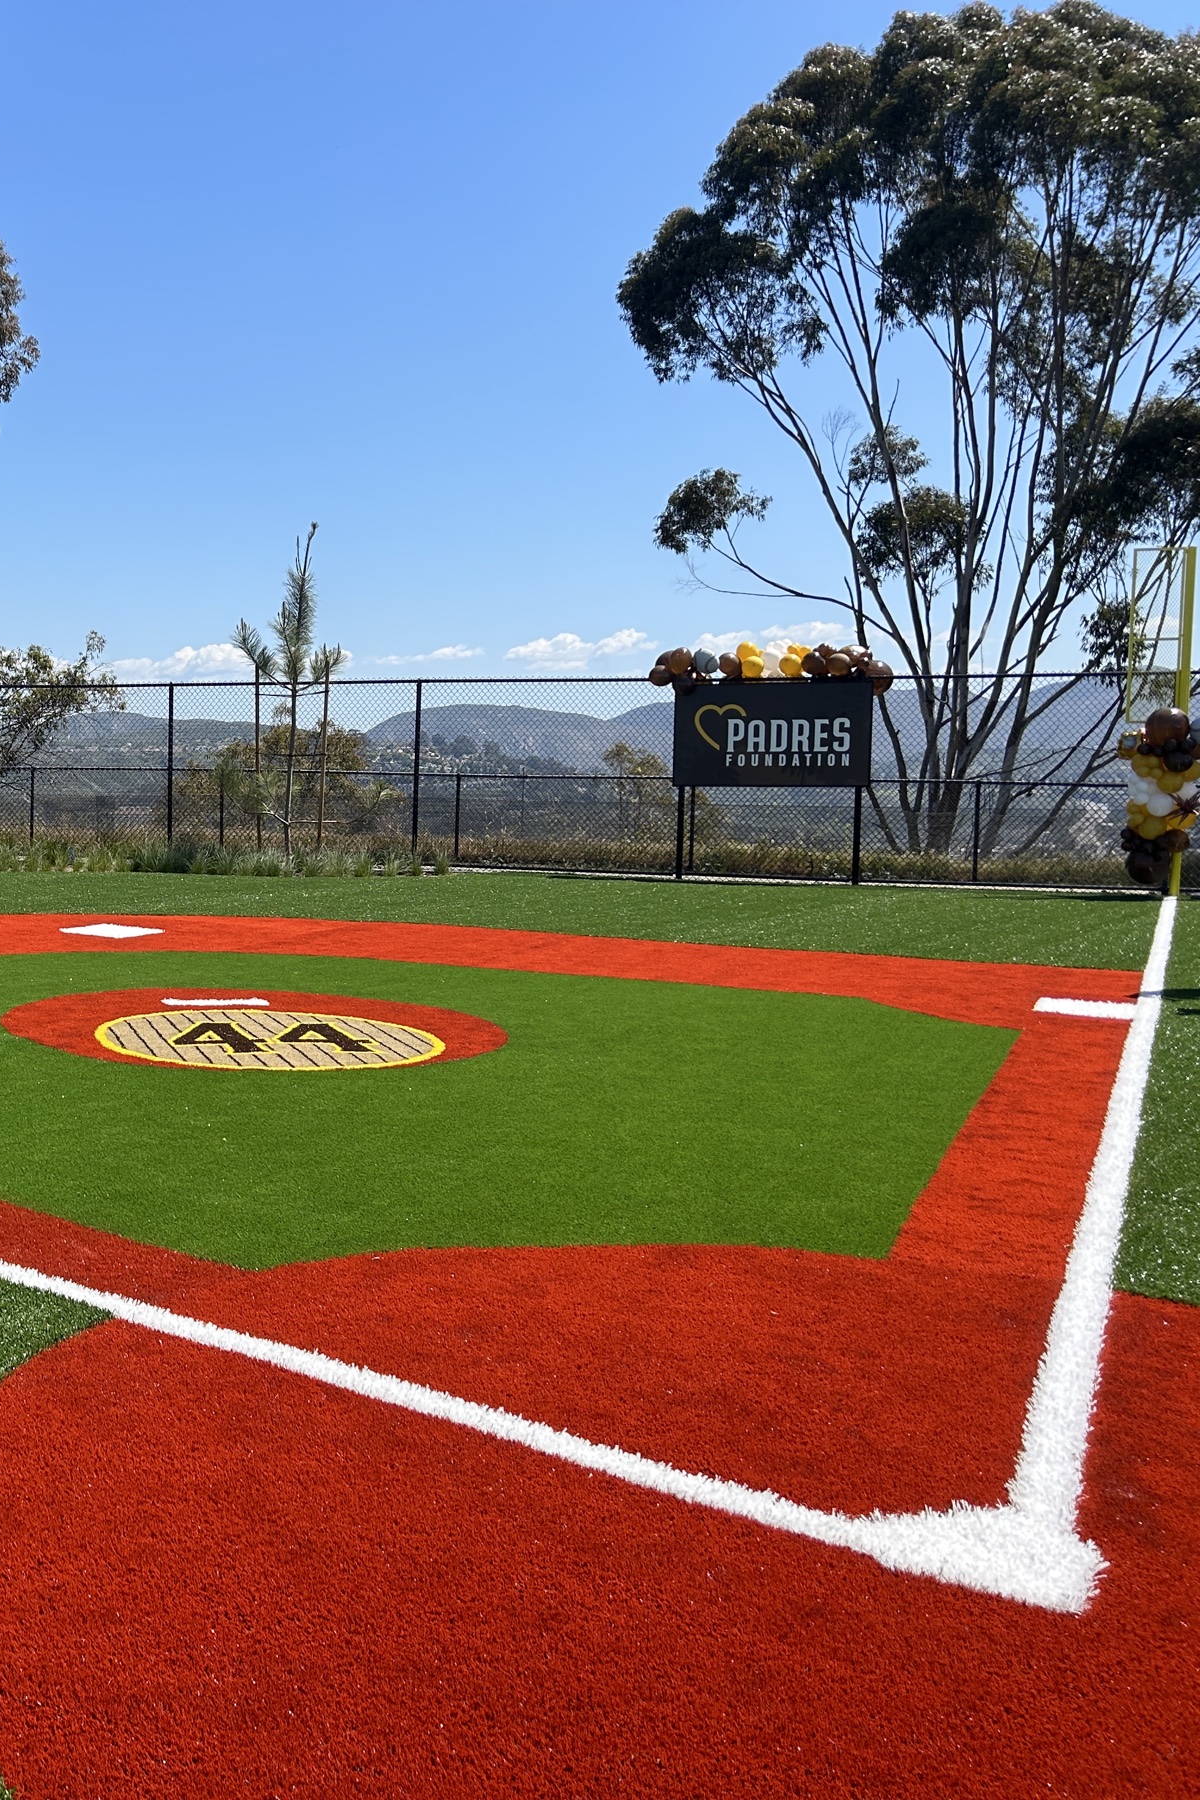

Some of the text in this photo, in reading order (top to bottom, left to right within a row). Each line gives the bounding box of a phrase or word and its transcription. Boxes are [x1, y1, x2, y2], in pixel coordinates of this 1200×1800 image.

[726, 717, 851, 752] PADRES
[725, 753, 850, 767] FOUNDATION
[169, 1021, 386, 1055] 44
